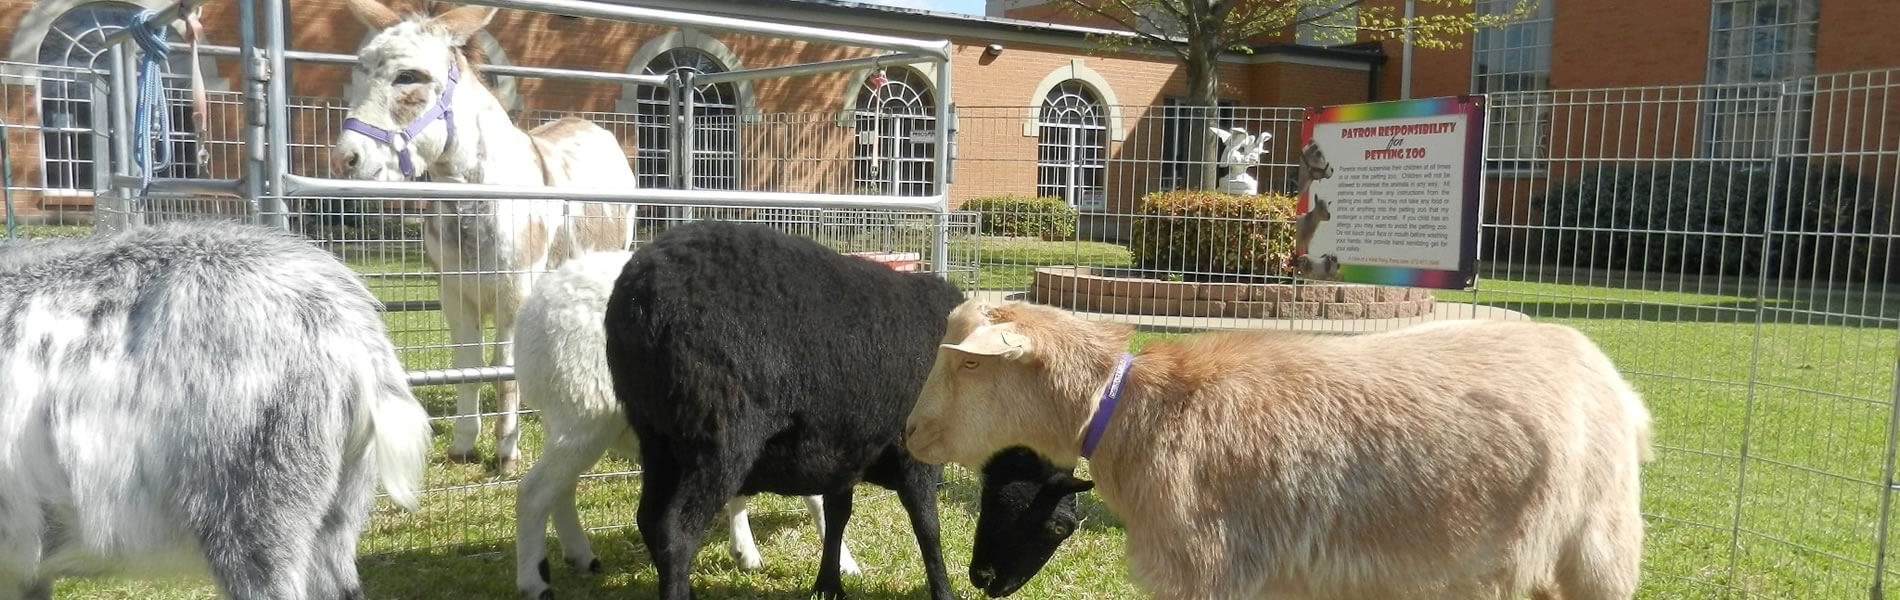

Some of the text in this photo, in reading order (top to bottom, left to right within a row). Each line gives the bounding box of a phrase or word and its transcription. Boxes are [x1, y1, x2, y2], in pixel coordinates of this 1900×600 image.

[1341, 122, 1457, 138] PATRON RESPONSIBILITY
[1387, 136, 1404, 150] for
[1365, 147, 1426, 160] PETTING ZOO
